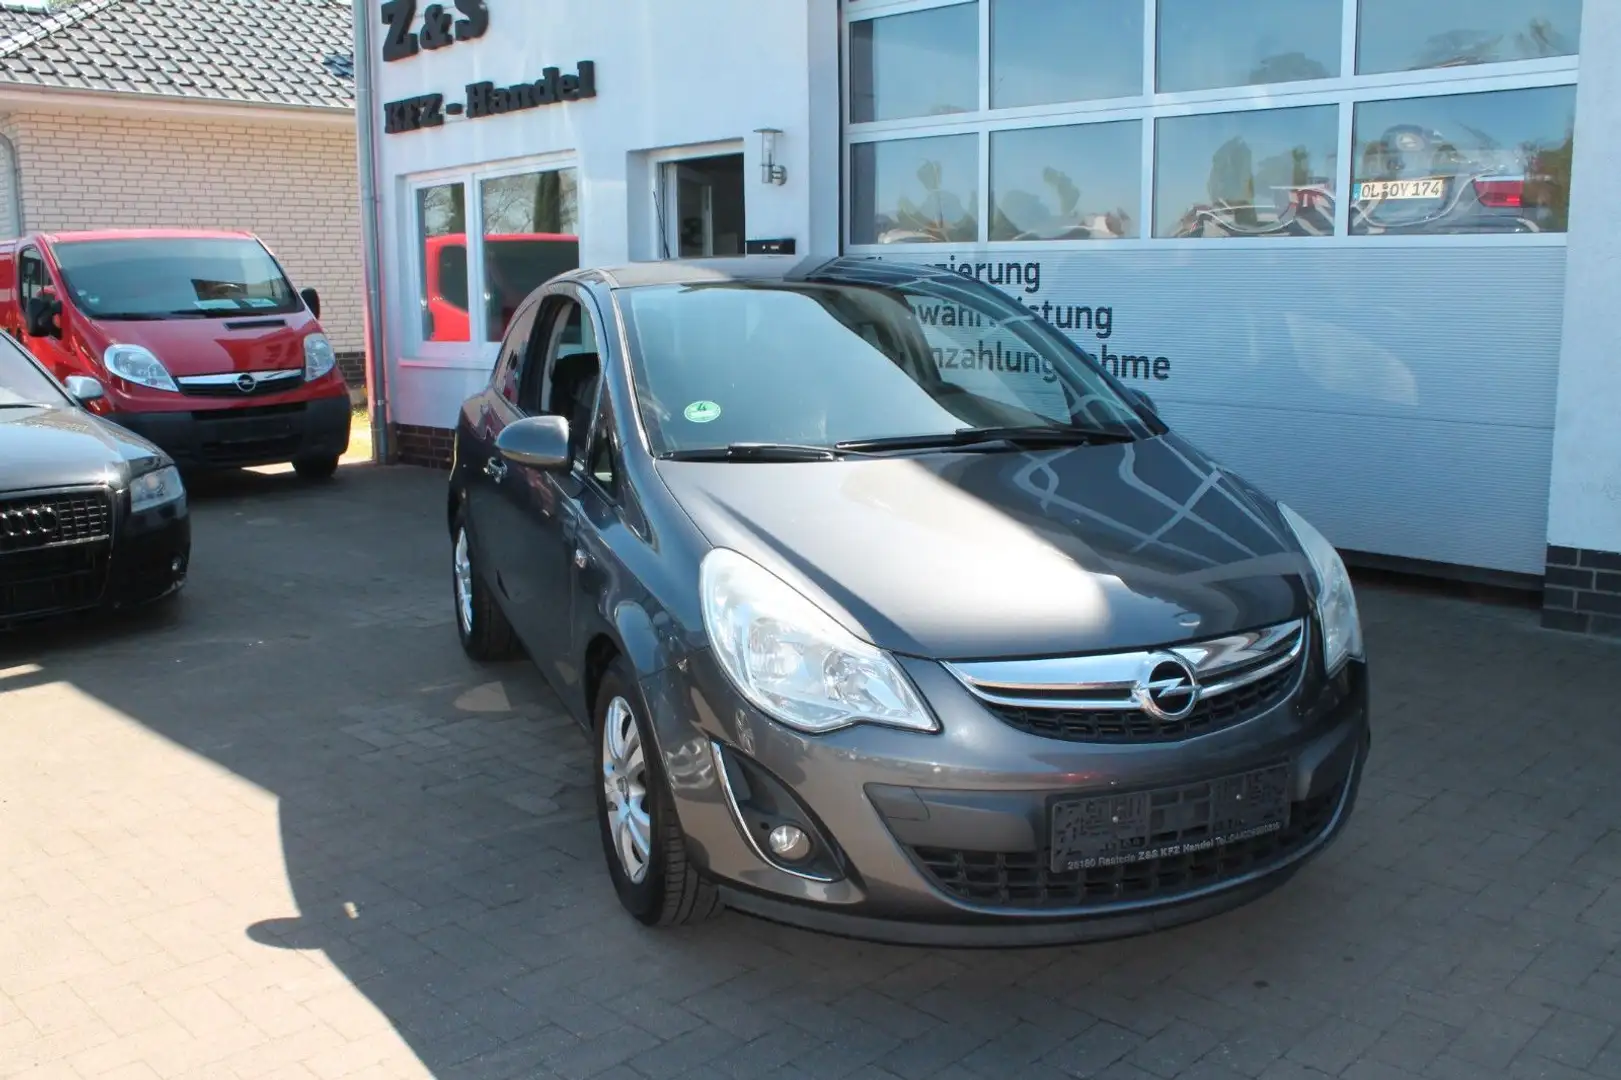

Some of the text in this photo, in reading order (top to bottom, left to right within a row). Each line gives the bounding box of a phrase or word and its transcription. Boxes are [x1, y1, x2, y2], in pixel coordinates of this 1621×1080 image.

[381, 0, 489, 62] Z&S
[1361, 184, 1379, 198] OL
[1411, 181, 1440, 196] 174
